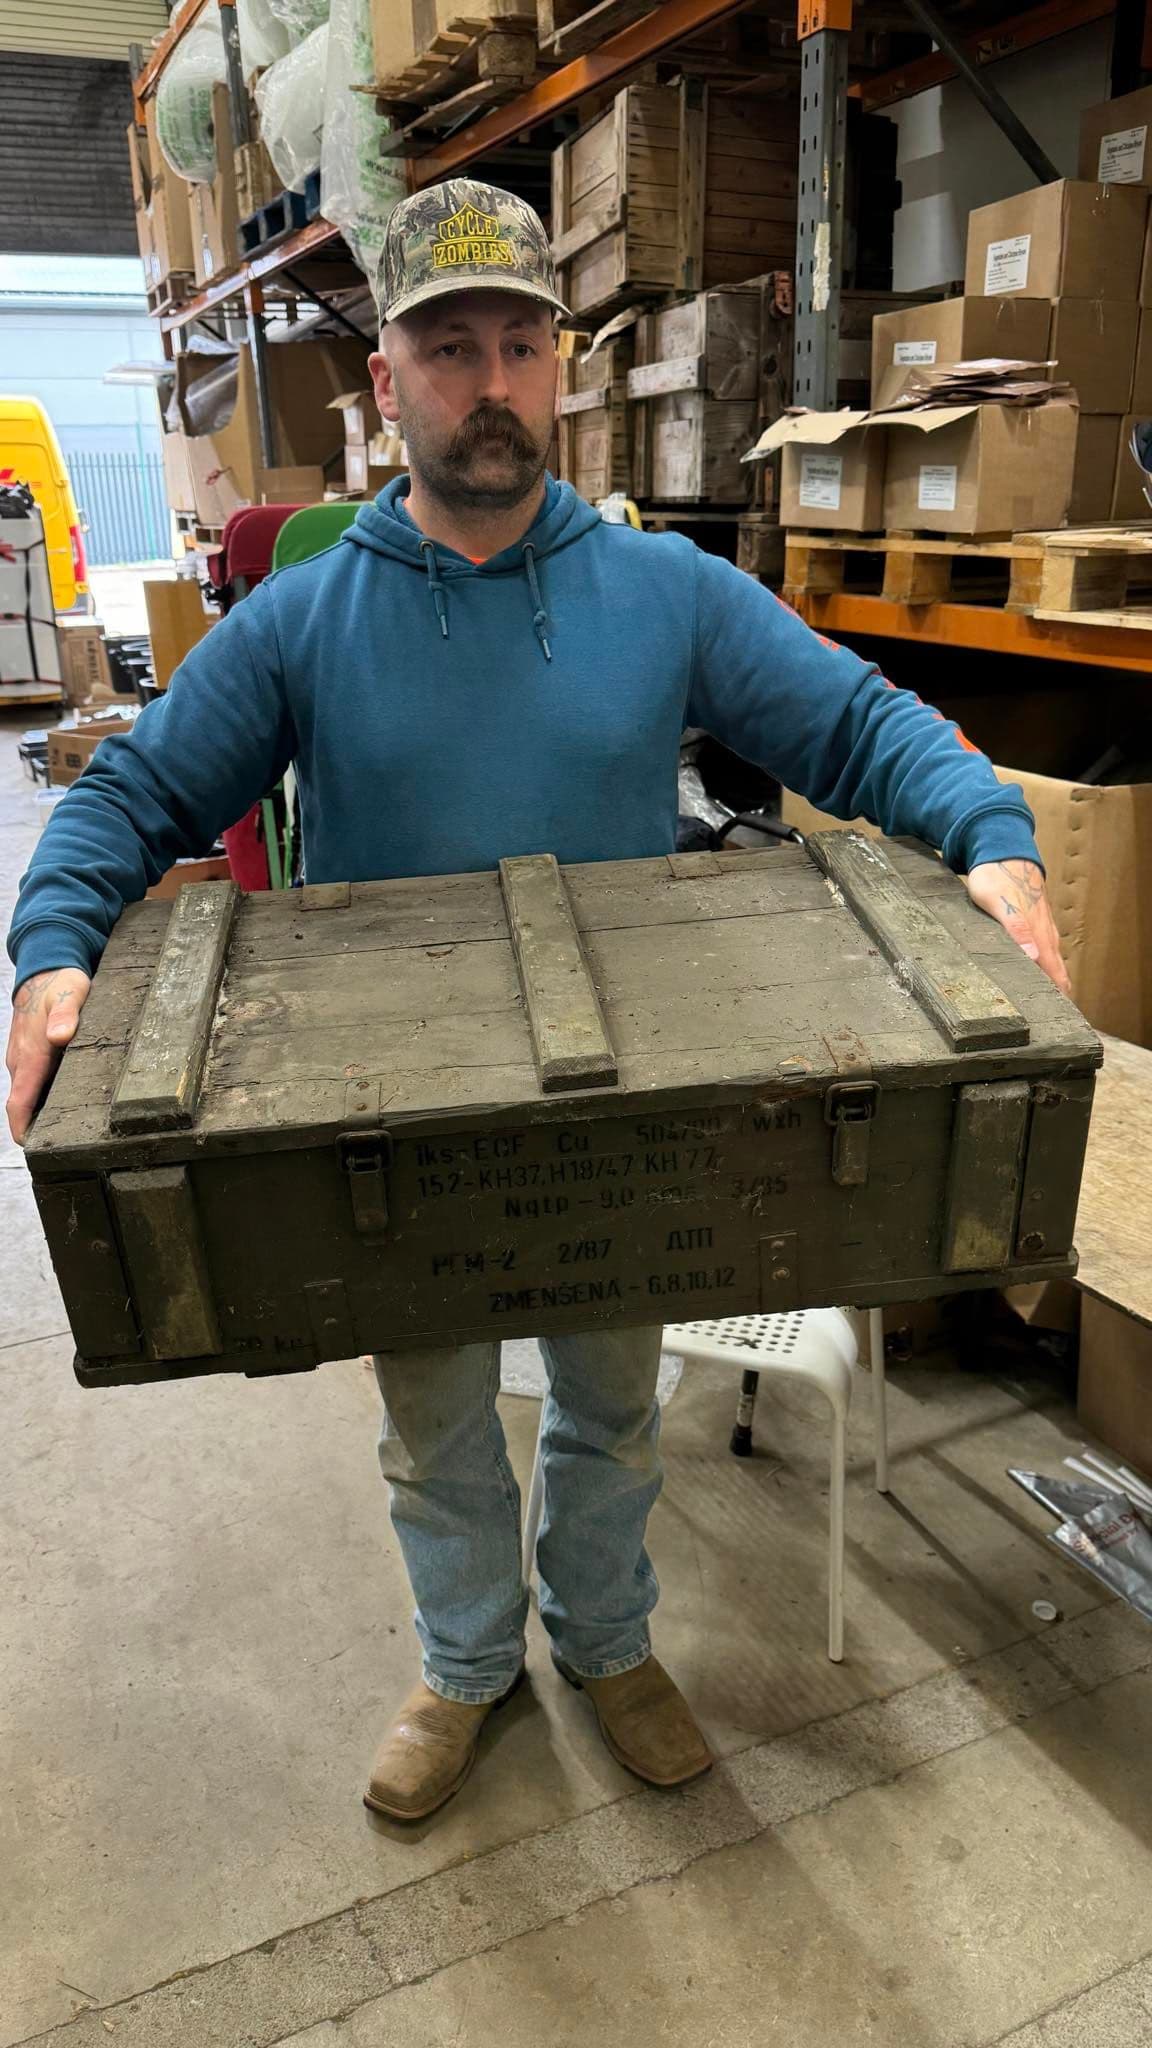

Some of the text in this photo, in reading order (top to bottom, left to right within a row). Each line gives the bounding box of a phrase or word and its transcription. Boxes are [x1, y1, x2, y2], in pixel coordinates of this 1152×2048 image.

[446, 210, 493, 239] CYCLE
[437, 241, 510, 264] ZOMBIES
[557, 1131, 590, 1154] Cu
[558, 1238, 613, 1264] 2/87
